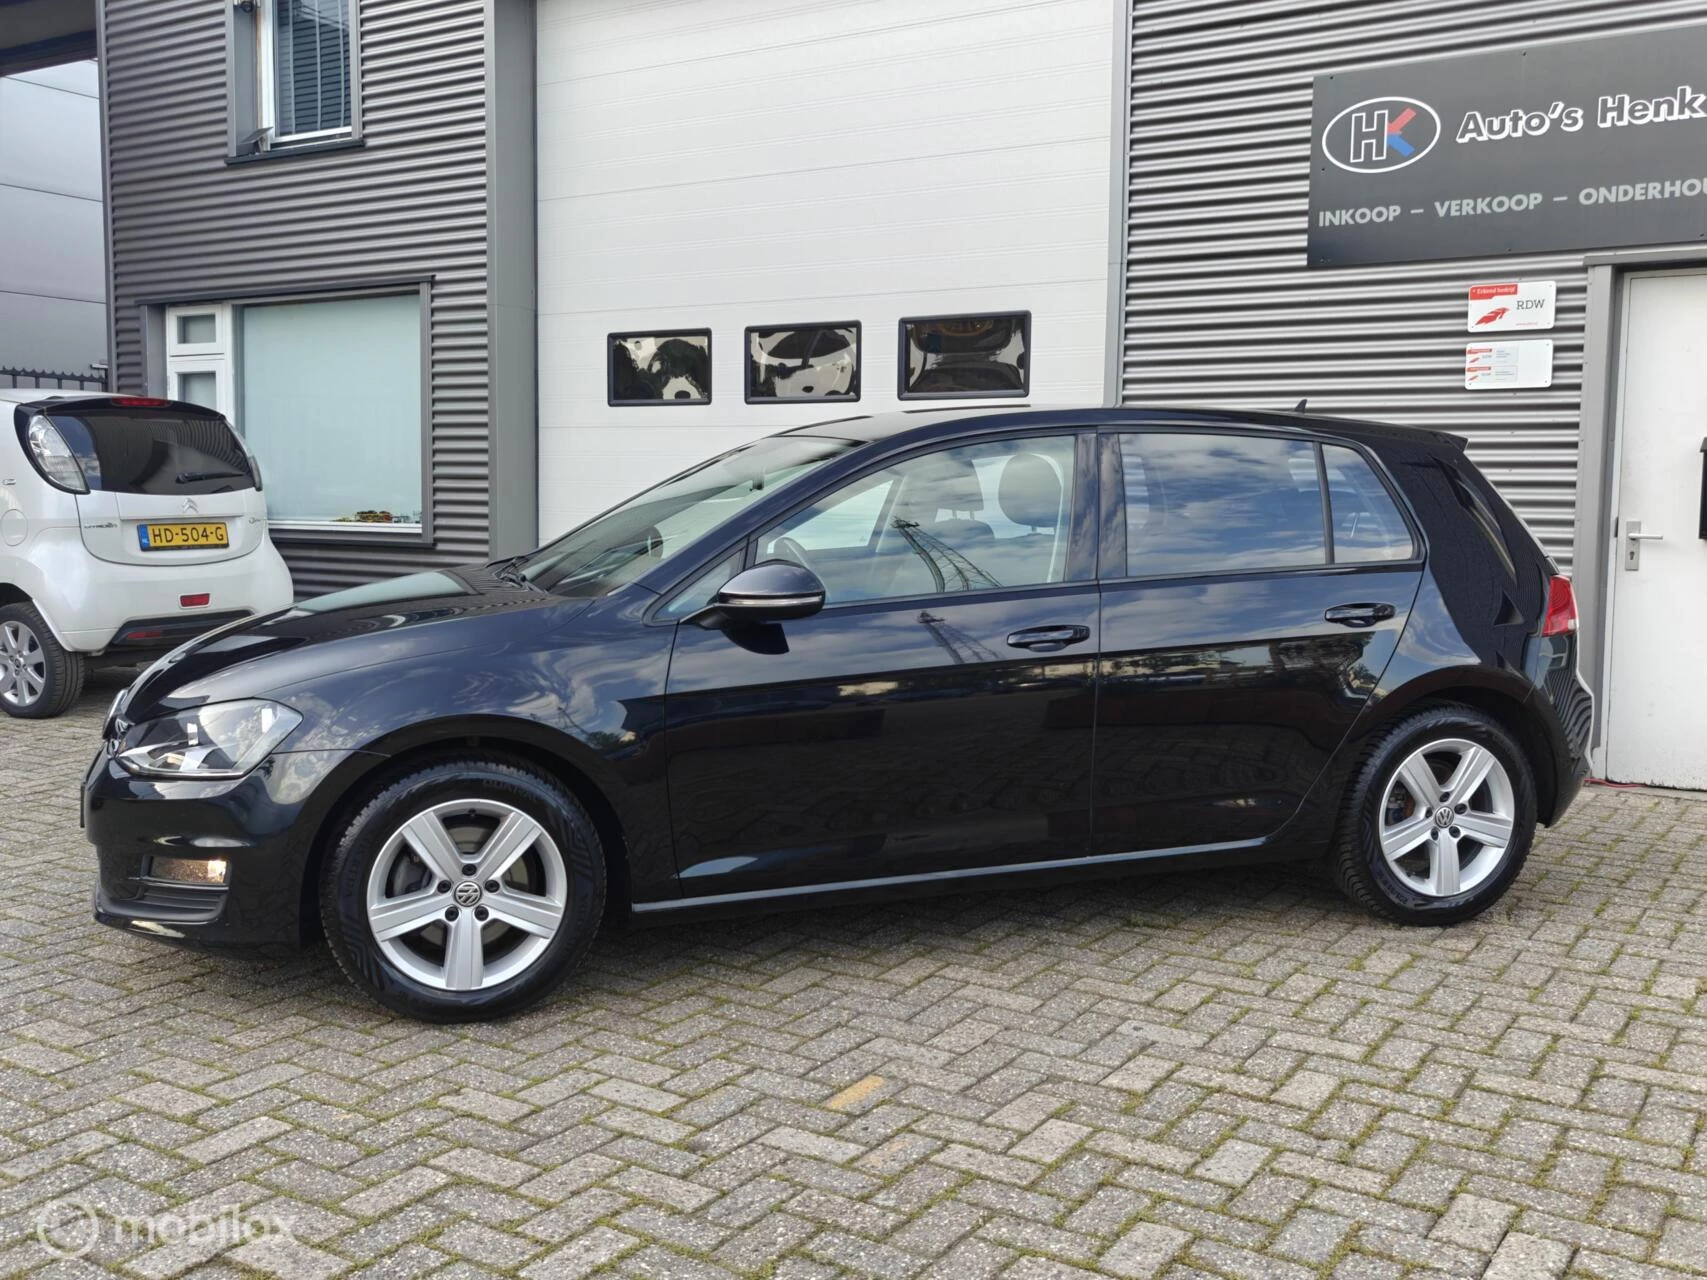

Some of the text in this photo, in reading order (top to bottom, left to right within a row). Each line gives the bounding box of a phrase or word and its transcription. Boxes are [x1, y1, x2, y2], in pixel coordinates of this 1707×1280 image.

[1597, 85, 1707, 129] Henk
[1318, 205, 1401, 228] INKOOP
[1434, 193, 1543, 218] VERKOOP
[1516, 299, 1546, 311] RDW
[151, 526, 225, 545] HD-504-G
